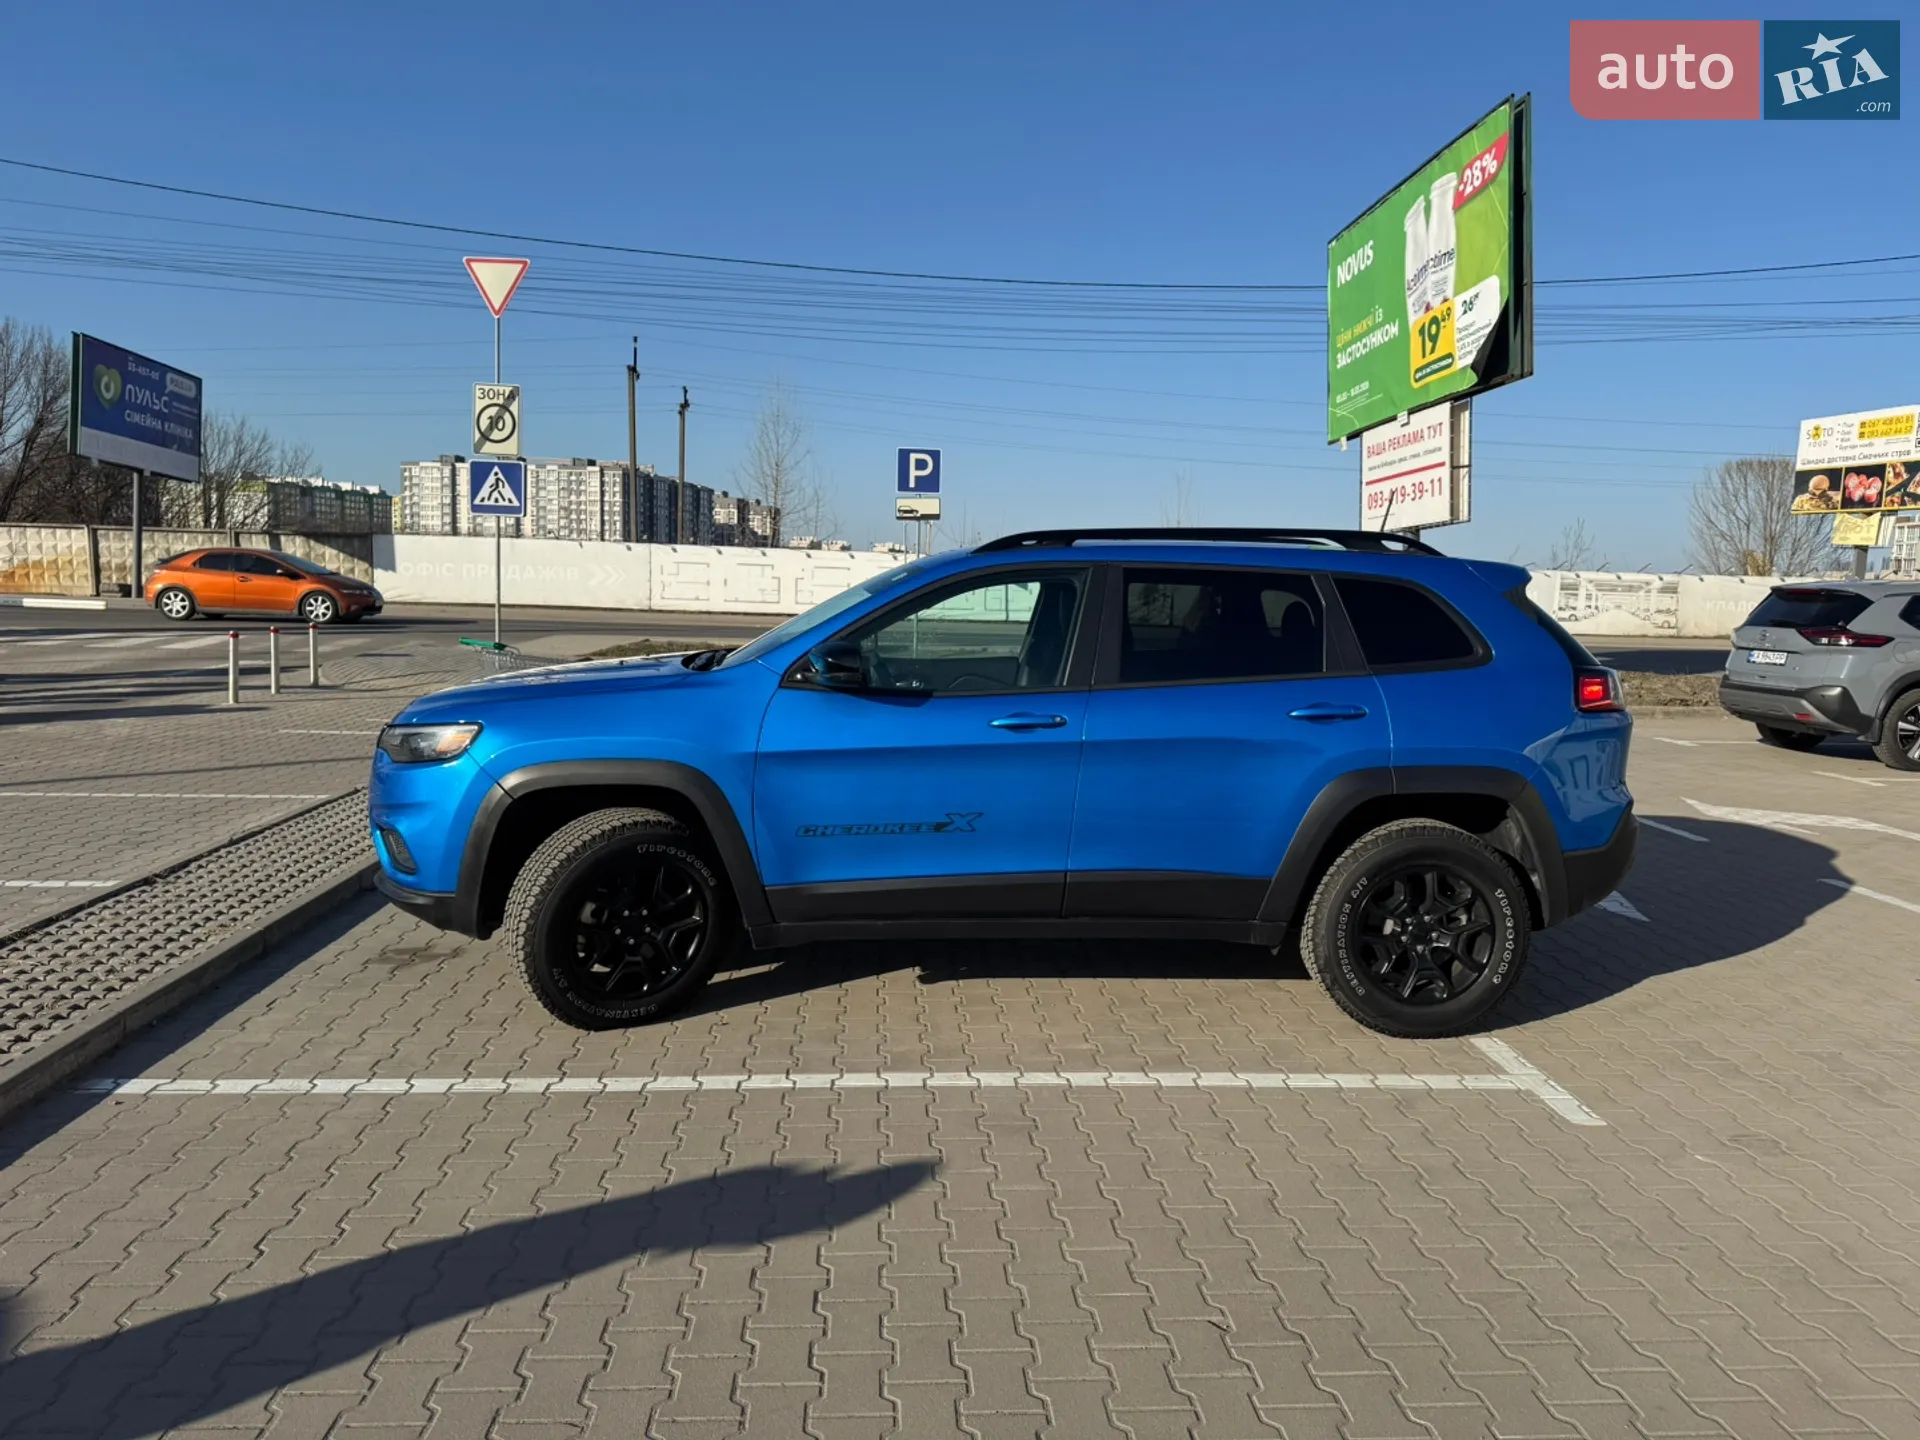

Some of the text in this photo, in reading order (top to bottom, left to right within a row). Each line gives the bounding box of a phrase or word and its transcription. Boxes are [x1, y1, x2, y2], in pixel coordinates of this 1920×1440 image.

[1459, 147, 1498, 197] -28%
[1336, 239, 1375, 289] NOVUS
[1336, 317, 1399, 370] ЗАСТОСУНКОМ
[1418, 315, 1441, 359] 19
[1440, 307, 1452, 324] 49
[125, 383, 170, 413] ПУЛЬС
[477, 387, 517, 401] ЗОНА
[124, 409, 162, 432] СІМЕЙНА
[163, 421, 194, 440] КЛІНІКА
[487, 415, 506, 431] 10
[1367, 421, 1444, 459] ВАША РЕКЛАМА ТУТ
[909, 453, 934, 488] P
[1827, 454, 1857, 463] доставка
[400, 561, 580, 582] ОФІС ПРОДАЖІВ
[796, 812, 984, 838] CHEROKEE X
[1337, 876, 1369, 996] DESTINATION A/T
[566, 991, 658, 1019] DESTINATION
